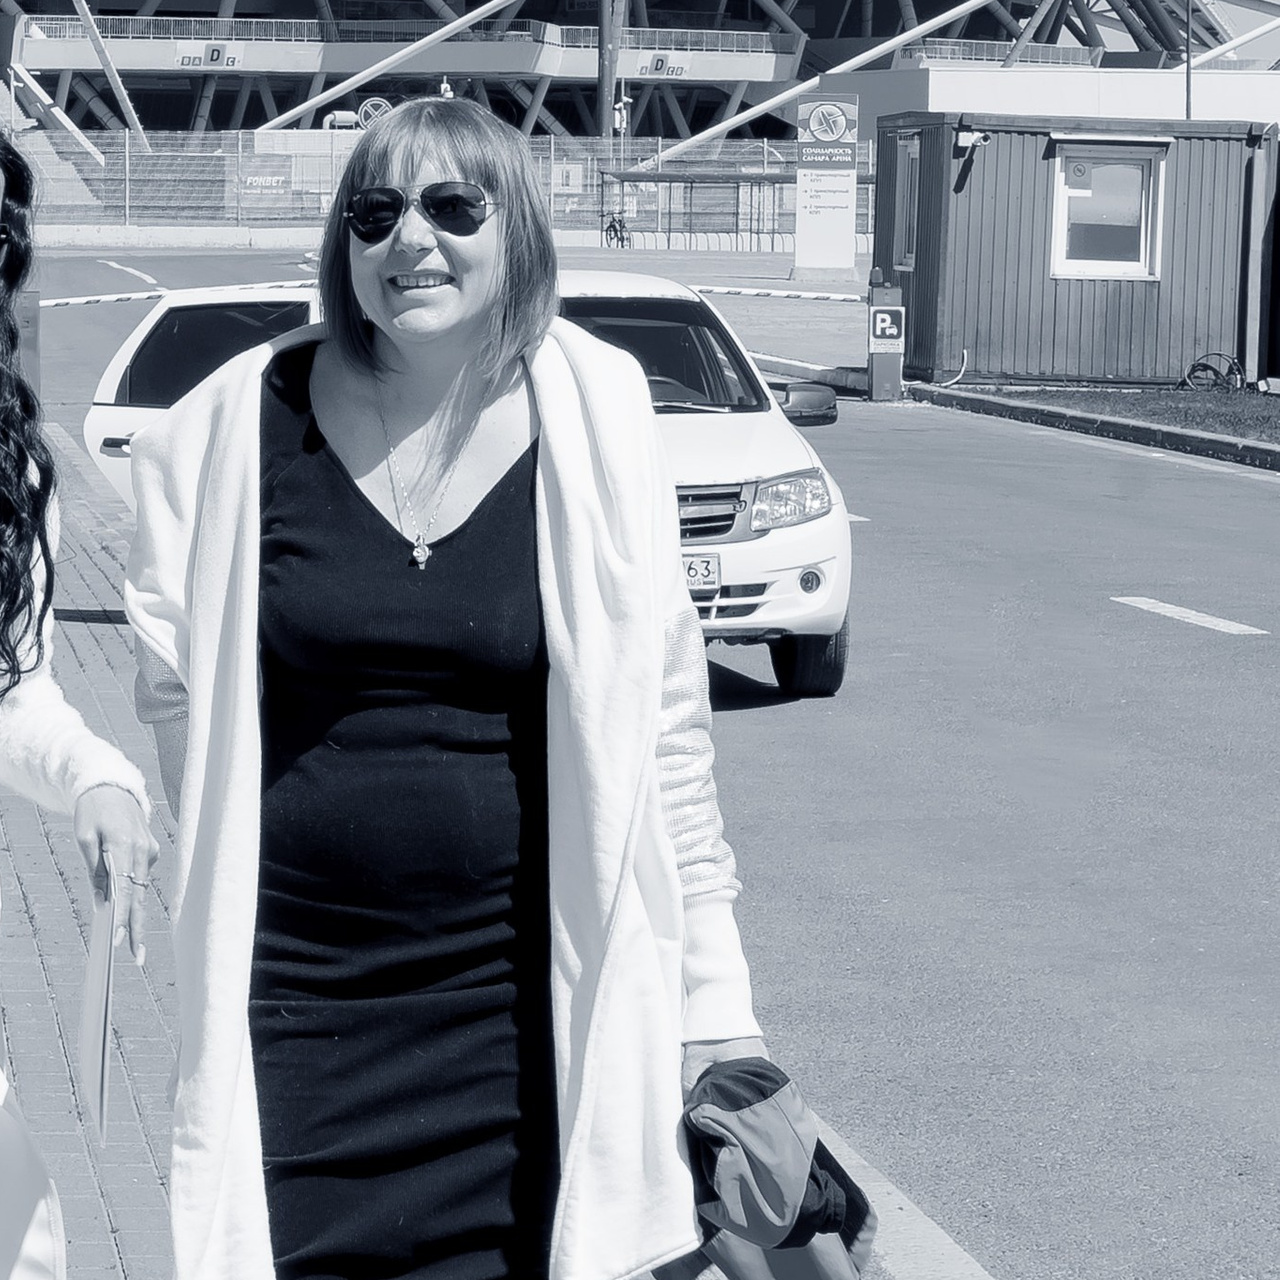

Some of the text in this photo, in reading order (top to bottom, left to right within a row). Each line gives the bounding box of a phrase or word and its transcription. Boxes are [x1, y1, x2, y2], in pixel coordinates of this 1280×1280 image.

[210, 48, 221, 62] D
[654, 58, 664, 71] D
[875, 313, 891, 335] P
